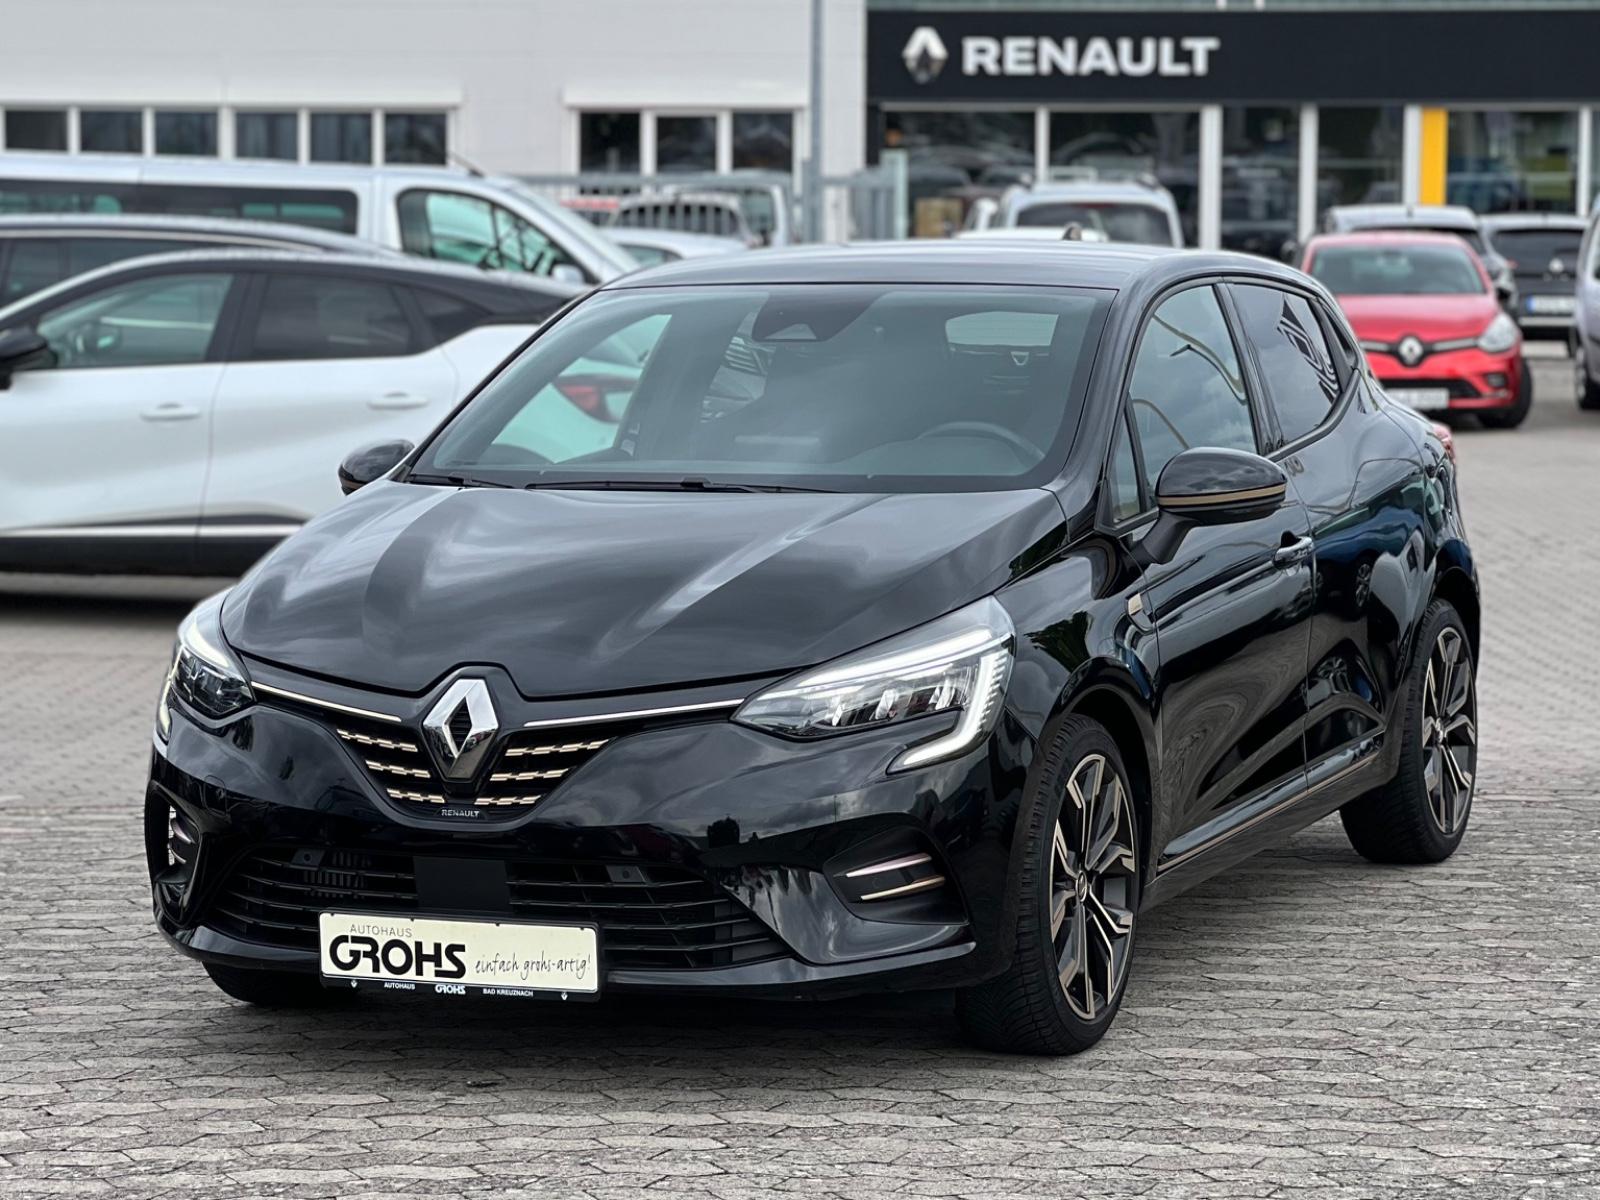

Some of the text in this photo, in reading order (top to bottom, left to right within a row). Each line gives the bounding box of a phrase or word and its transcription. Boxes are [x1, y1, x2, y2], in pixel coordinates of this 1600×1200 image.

[961, 36, 1221, 77] RENAULT
[441, 809, 480, 818] RENAULT
[350, 923, 413, 938] AUTOHAUS
[329, 934, 467, 979] GROHS
[475, 949, 592, 981] einfach grohs-artig!
[383, 981, 534, 997] AUTOHAUS GROHS BAD KREUZNACH
